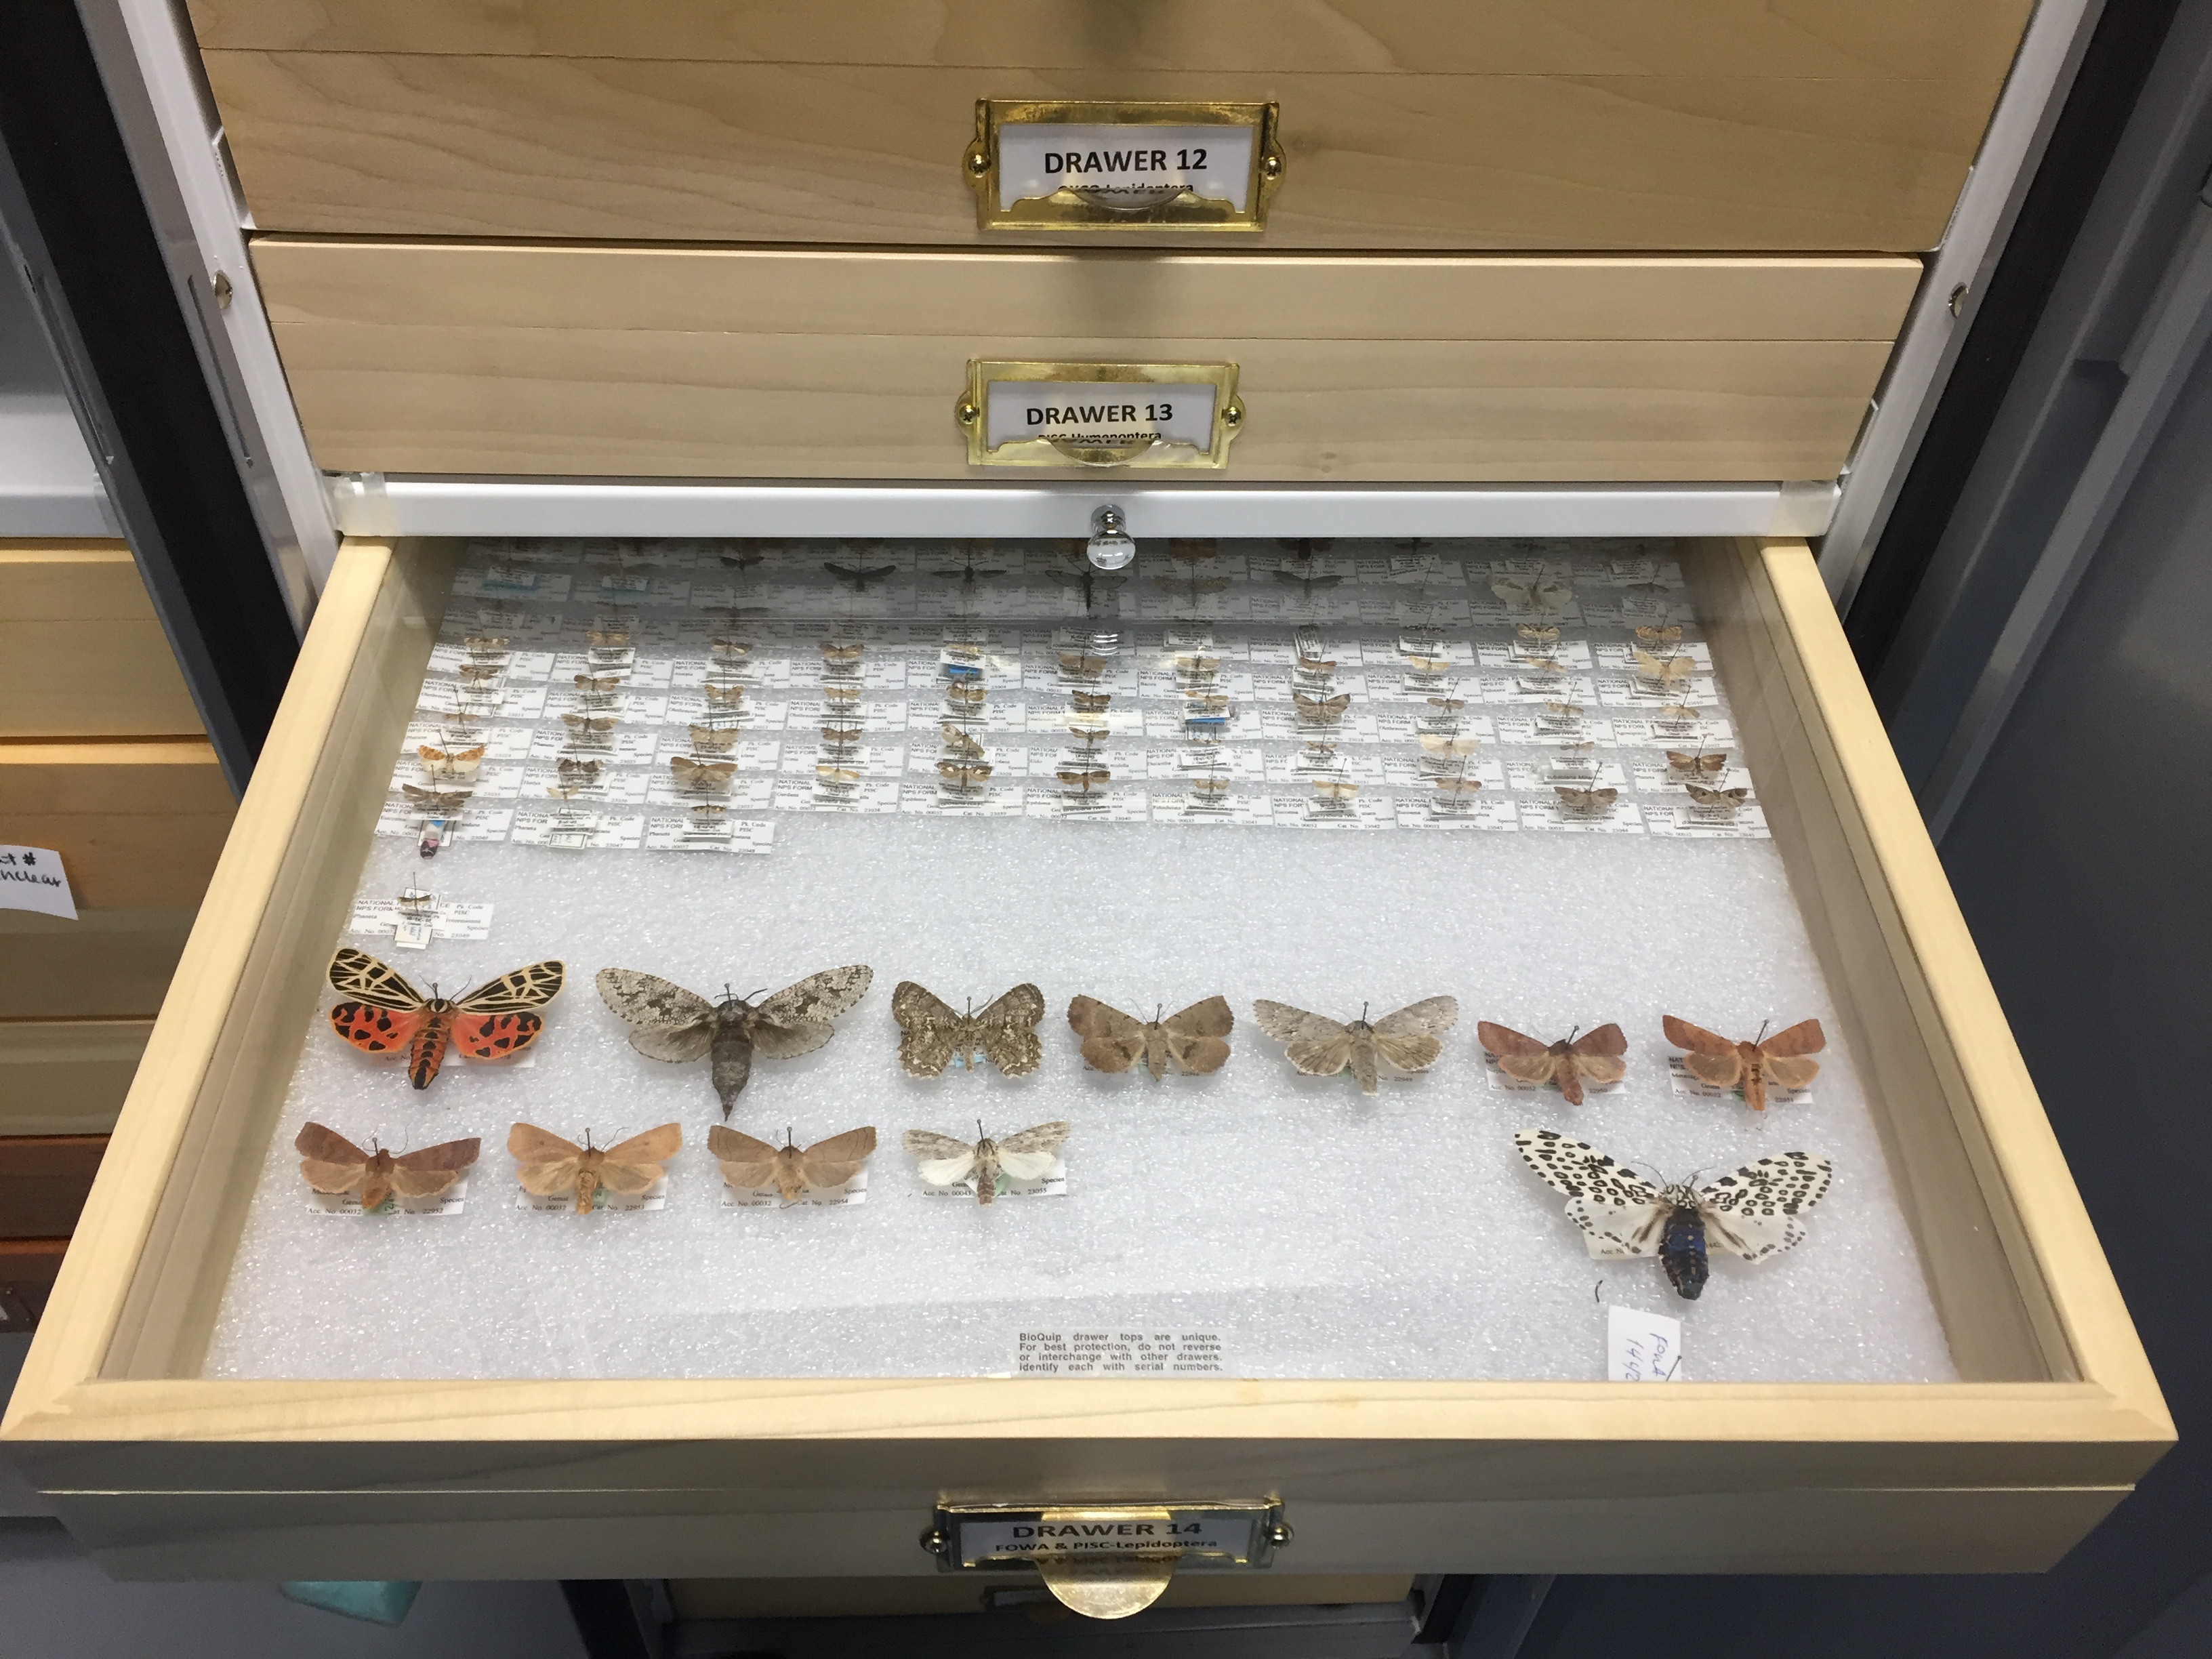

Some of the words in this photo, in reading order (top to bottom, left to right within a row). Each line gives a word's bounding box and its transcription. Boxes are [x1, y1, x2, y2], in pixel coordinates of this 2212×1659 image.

[1045, 150, 1166, 173] DRAWER
[1176, 148, 1207, 170] 12
[1027, 405, 1136, 426] DRAWER
[1145, 404, 1173, 422] 13
[1019, 1333, 1062, 1343] BioQuip
[1073, 1333, 1109, 1341] drawer
[1120, 1334, 1143, 1342] tops
[1182, 1333, 1221, 1343] unique.
[1019, 1343, 1037, 1351] For
[1044, 1343, 1066, 1351] best
[1074, 1343, 1130, 1353] protection,
[1138, 1343, 1151, 1351] do
[1159, 1343, 1176, 1351] not
[1039, 1353, 1101, 1363] interchange
[1110, 1353, 1132, 1361] with
[1141, 1353, 1168, 1361] other
[1176, 1353, 1223, 1361] drawers.
[1069, 1363, 1093, 1372] each
[1103, 1363, 1125, 1371] with
[1135, 1363, 1164, 1371] serial
[1173, 1363, 1223, 1372] numbers.
[1013, 1523, 1155, 1538] DRAWER
[1166, 1522, 1202, 1535] 14
[996, 1543, 1050, 1551] FOWA
[1054, 1542, 1068, 1551] &
[1073, 1540, 1217, 1550] PISC-Lepidoptera
